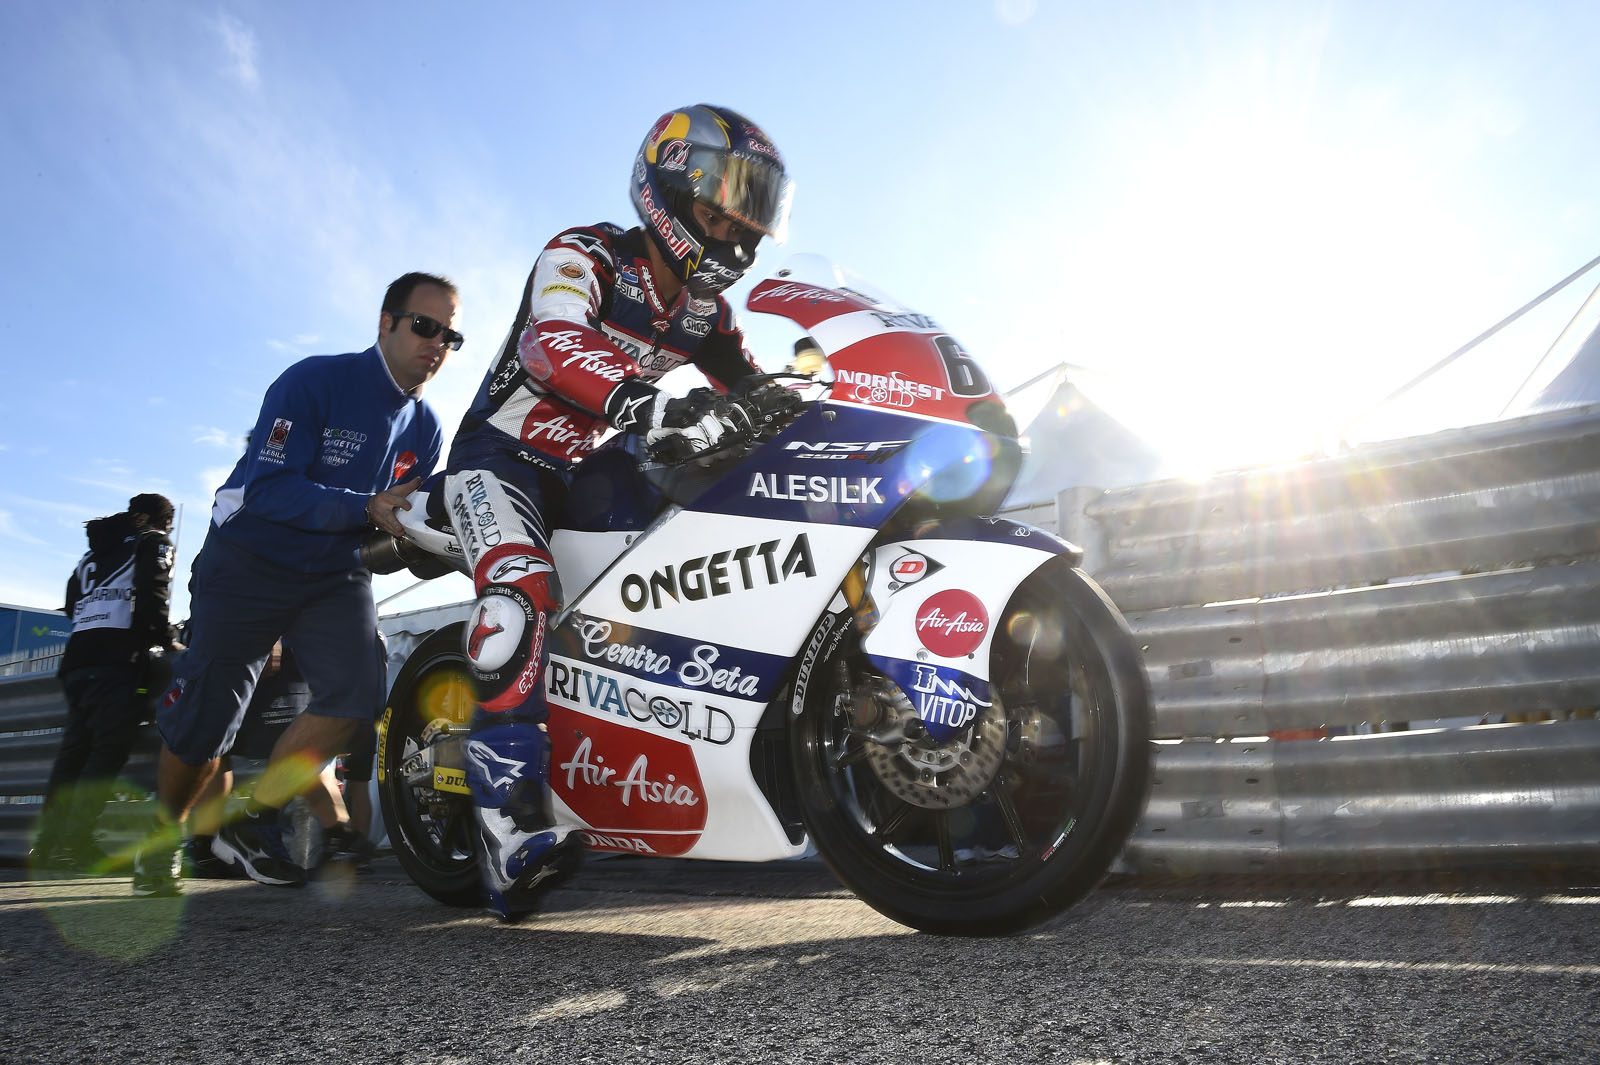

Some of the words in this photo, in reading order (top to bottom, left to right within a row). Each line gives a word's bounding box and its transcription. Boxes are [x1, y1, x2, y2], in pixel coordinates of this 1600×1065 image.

[748, 472, 884, 504] ALESILK
[620, 532, 817, 613] ONGETTA
[580, 619, 671, 675] Centro
[679, 644, 760, 697] Seta
[795, 615, 834, 698] DUNLOP
[548, 660, 736, 746] RIVACOLD
[920, 692, 977, 728] VITOP
